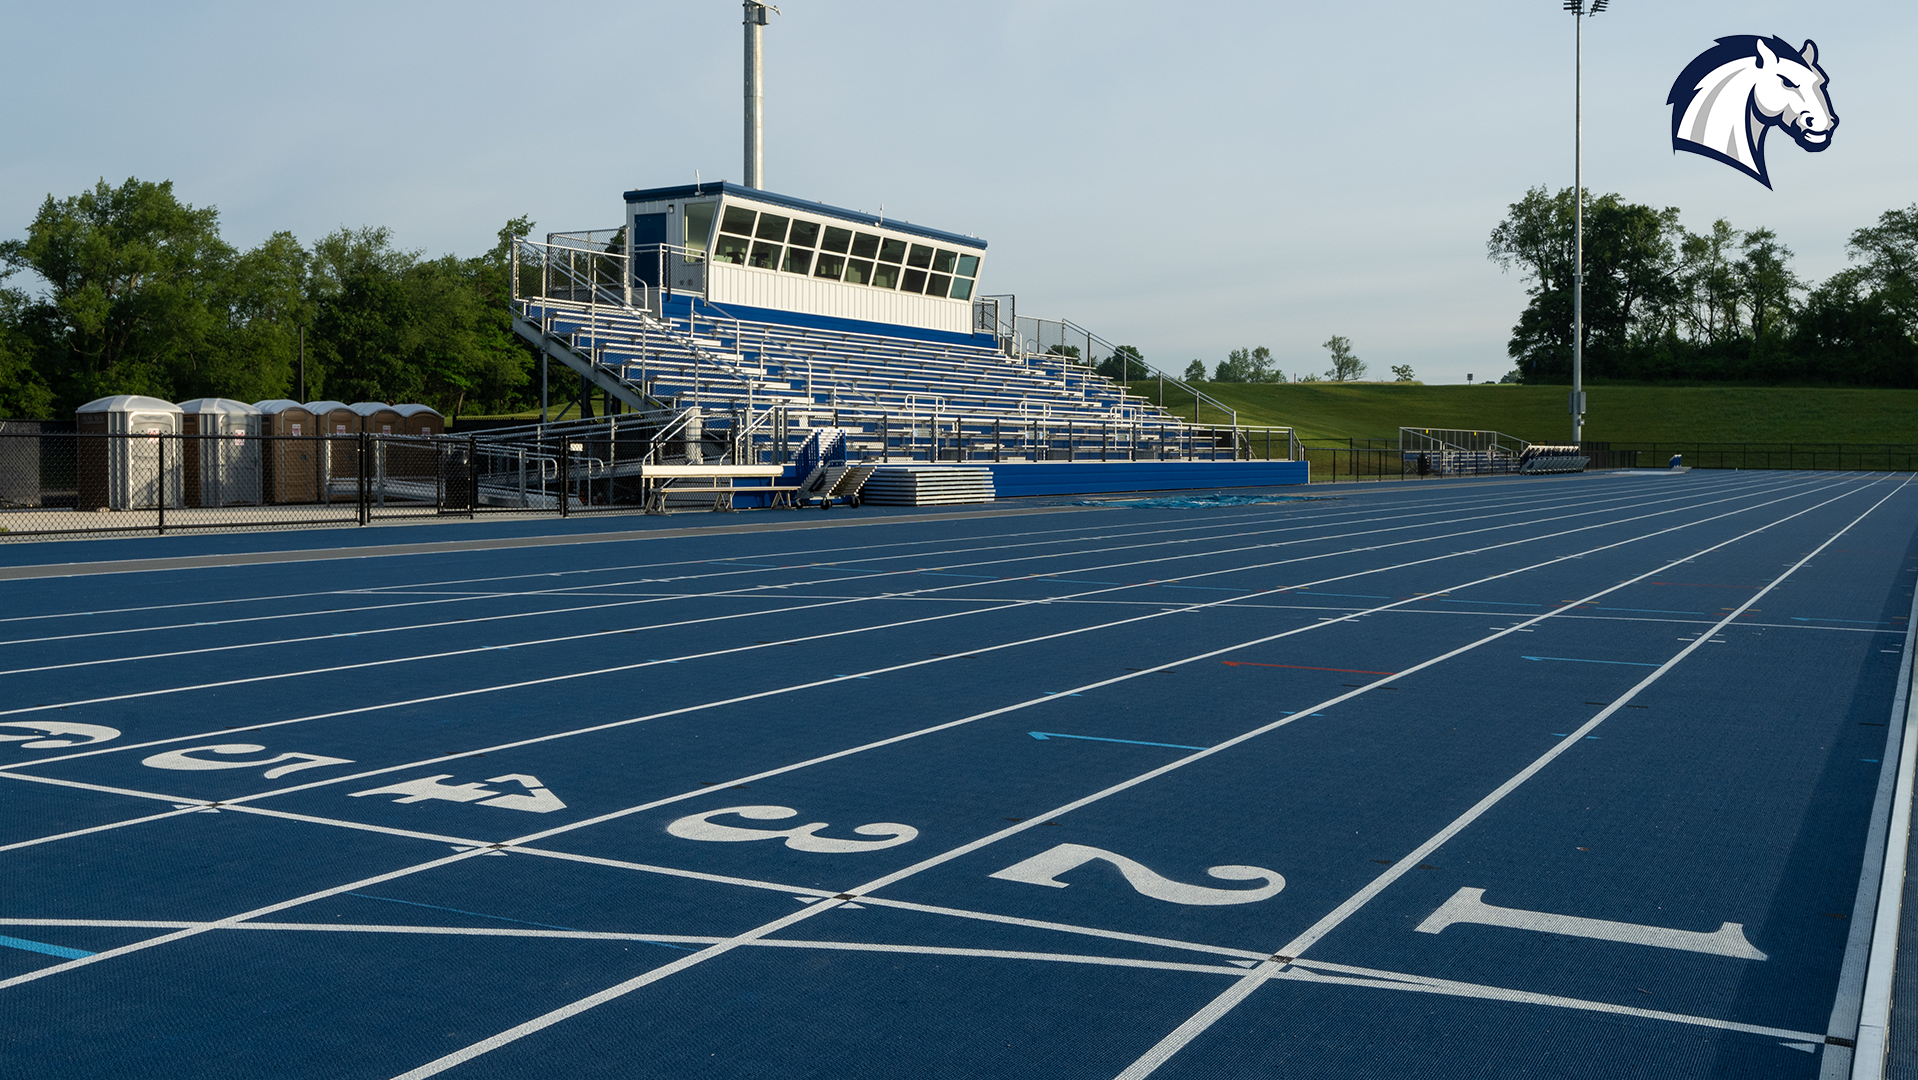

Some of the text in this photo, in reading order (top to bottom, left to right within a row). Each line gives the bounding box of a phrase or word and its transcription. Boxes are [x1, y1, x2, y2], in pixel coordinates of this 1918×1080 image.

[0, 721, 121, 749] 6
[142, 744, 355, 779] 5
[348, 774, 567, 813] 4
[666, 805, 918, 853] 3
[989, 843, 1286, 905] 2
[1415, 887, 1768, 960] 1
